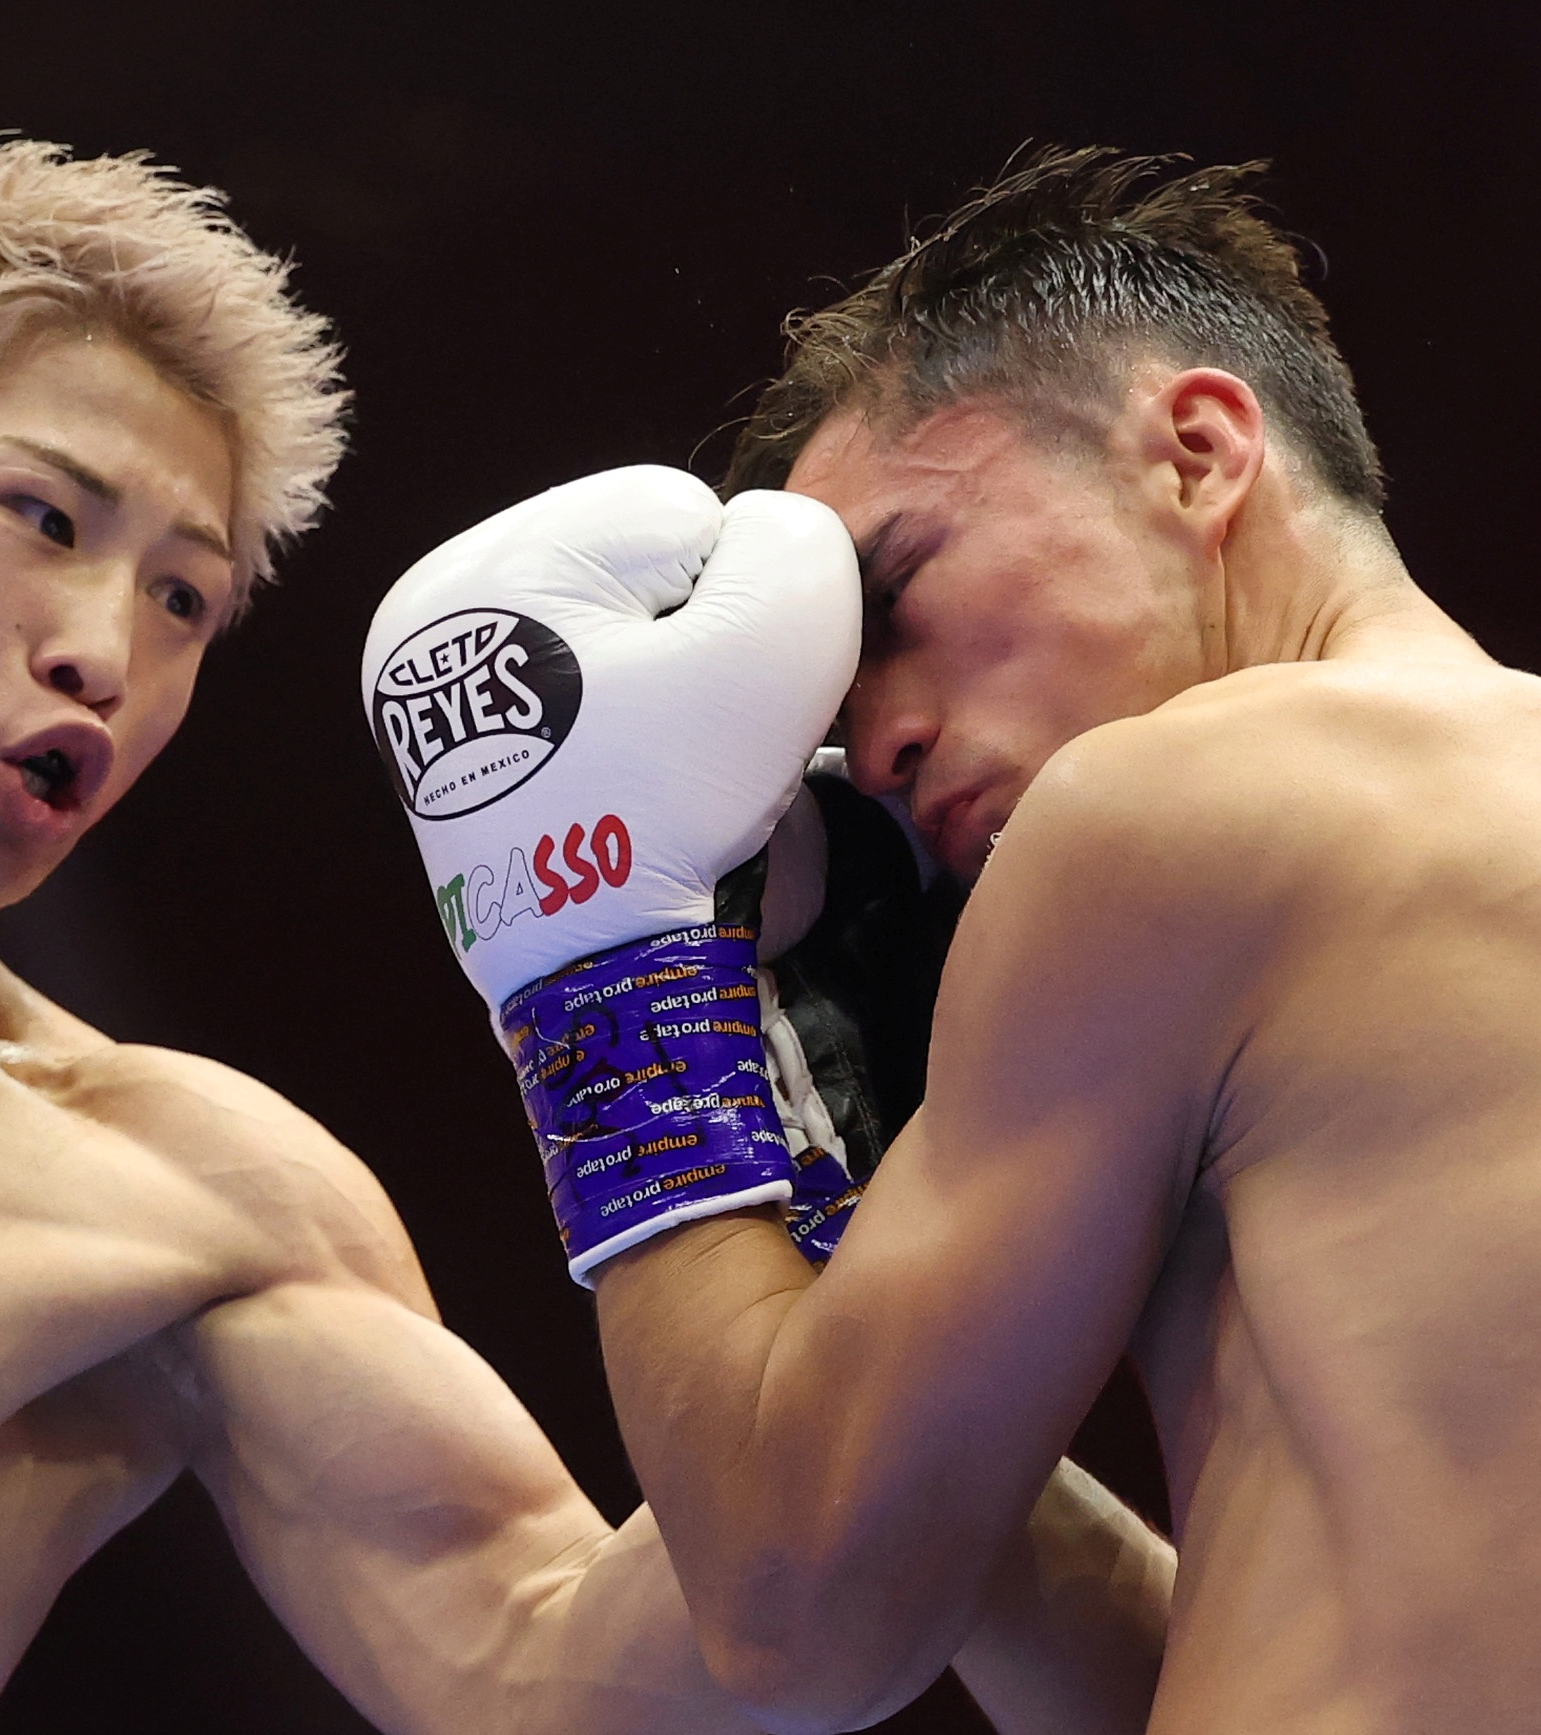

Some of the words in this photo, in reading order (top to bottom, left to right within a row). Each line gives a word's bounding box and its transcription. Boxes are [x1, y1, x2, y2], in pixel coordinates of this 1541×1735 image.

[389, 621, 498, 686] CLETO
[382, 644, 543, 801] REYES
[423, 781, 457, 806] HECHO
[461, 772, 476, 786] EN
[480, 750, 530, 776] MEXICO
[437, 814, 632, 960] PICASSO
[690, 924, 717, 940] pro
[718, 926, 755, 941] mpire
[602, 977, 633, 998] pro
[691, 986, 718, 1002] pro
[564, 989, 603, 1012] tape
[650, 994, 691, 1013] tape
[681, 1018, 711, 1033] pro
[606, 1146, 632, 1167] pro
[637, 1134, 699, 1158] empire
[576, 1161, 606, 1179] tape
[663, 1164, 727, 1191] empire
[632, 1180, 662, 1201] pro
[600, 1194, 633, 1218] tape
[798, 1209, 826, 1235] pro
